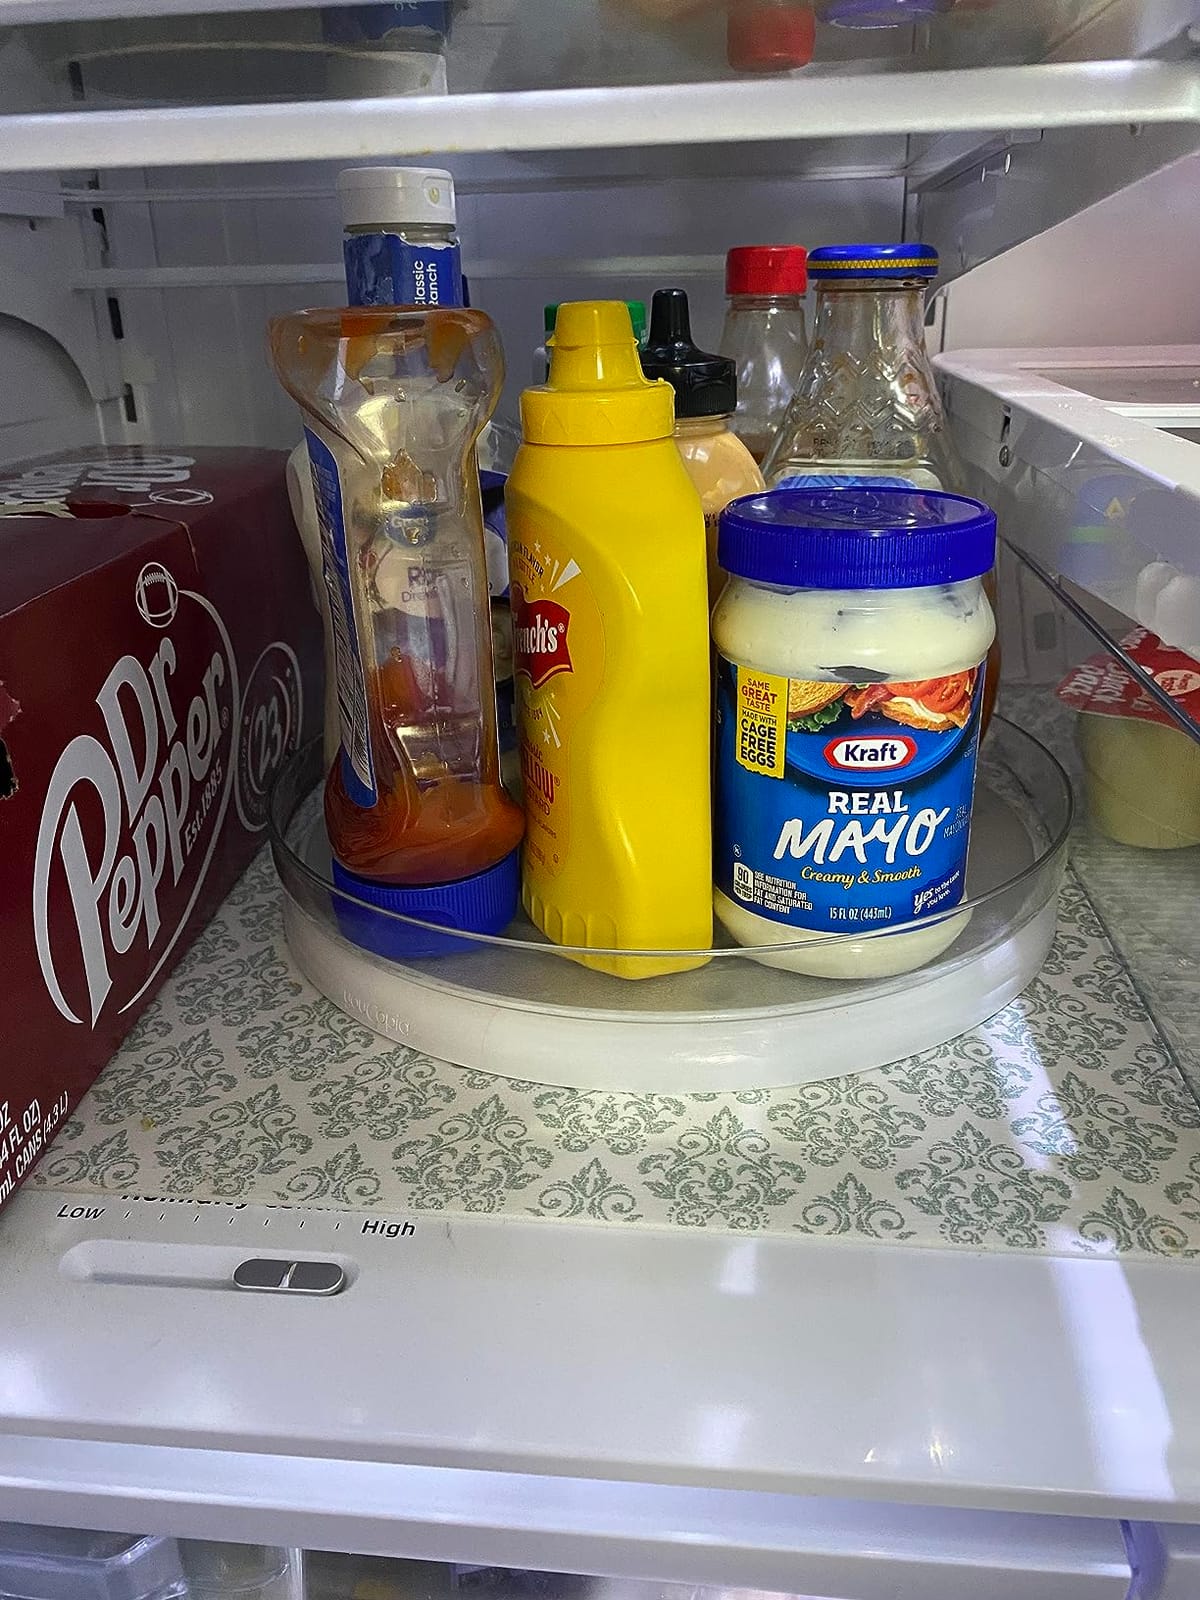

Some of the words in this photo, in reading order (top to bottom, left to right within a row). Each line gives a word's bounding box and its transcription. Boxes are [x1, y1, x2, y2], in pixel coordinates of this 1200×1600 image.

[741, 685, 778, 704] GREAT
[747, 678, 770, 691] SAME
[746, 698, 770, 712] TASTE
[742, 709, 759, 722] MADE
[759, 715, 777, 726] WITH
[96, 637, 178, 829] Dr
[255, 695, 282, 782] 23
[741, 718, 777, 740] CAGE
[741, 731, 776, 756] FREE
[844, 743, 898, 762] Kraft
[740, 745, 776, 768] EGGS
[828, 791, 909, 814] REAL
[33, 651, 225, 1031] Pepper
[773, 807, 950, 865] MAYO
[738, 867, 749, 884] 90
[754, 870, 765, 880] SEE
[765, 875, 797, 890] NUTRITION
[801, 866, 855, 889] Creamy
[857, 870, 871, 884] &
[872, 865, 922, 884] Smooth
[754, 880, 793, 898] INFORMATION
[794, 890, 807, 900] FOR
[754, 887, 764, 898] FAT
[765, 891, 777, 902] AND
[777, 895, 813, 911] SATURATED
[754, 896, 764, 906] FAT
[764, 900, 791, 914] CONTENT
[829, 907, 837, 919] 15
[838, 908, 847, 920] FL
[848, 908, 858, 920] OZ
[9, 1124, 23, 1154] FL
[23, 1099, 41, 1133] OZ)
[15, 1128, 42, 1178] CANS
[57, 1204, 106, 1219] Low
[361, 1220, 416, 1238] High
